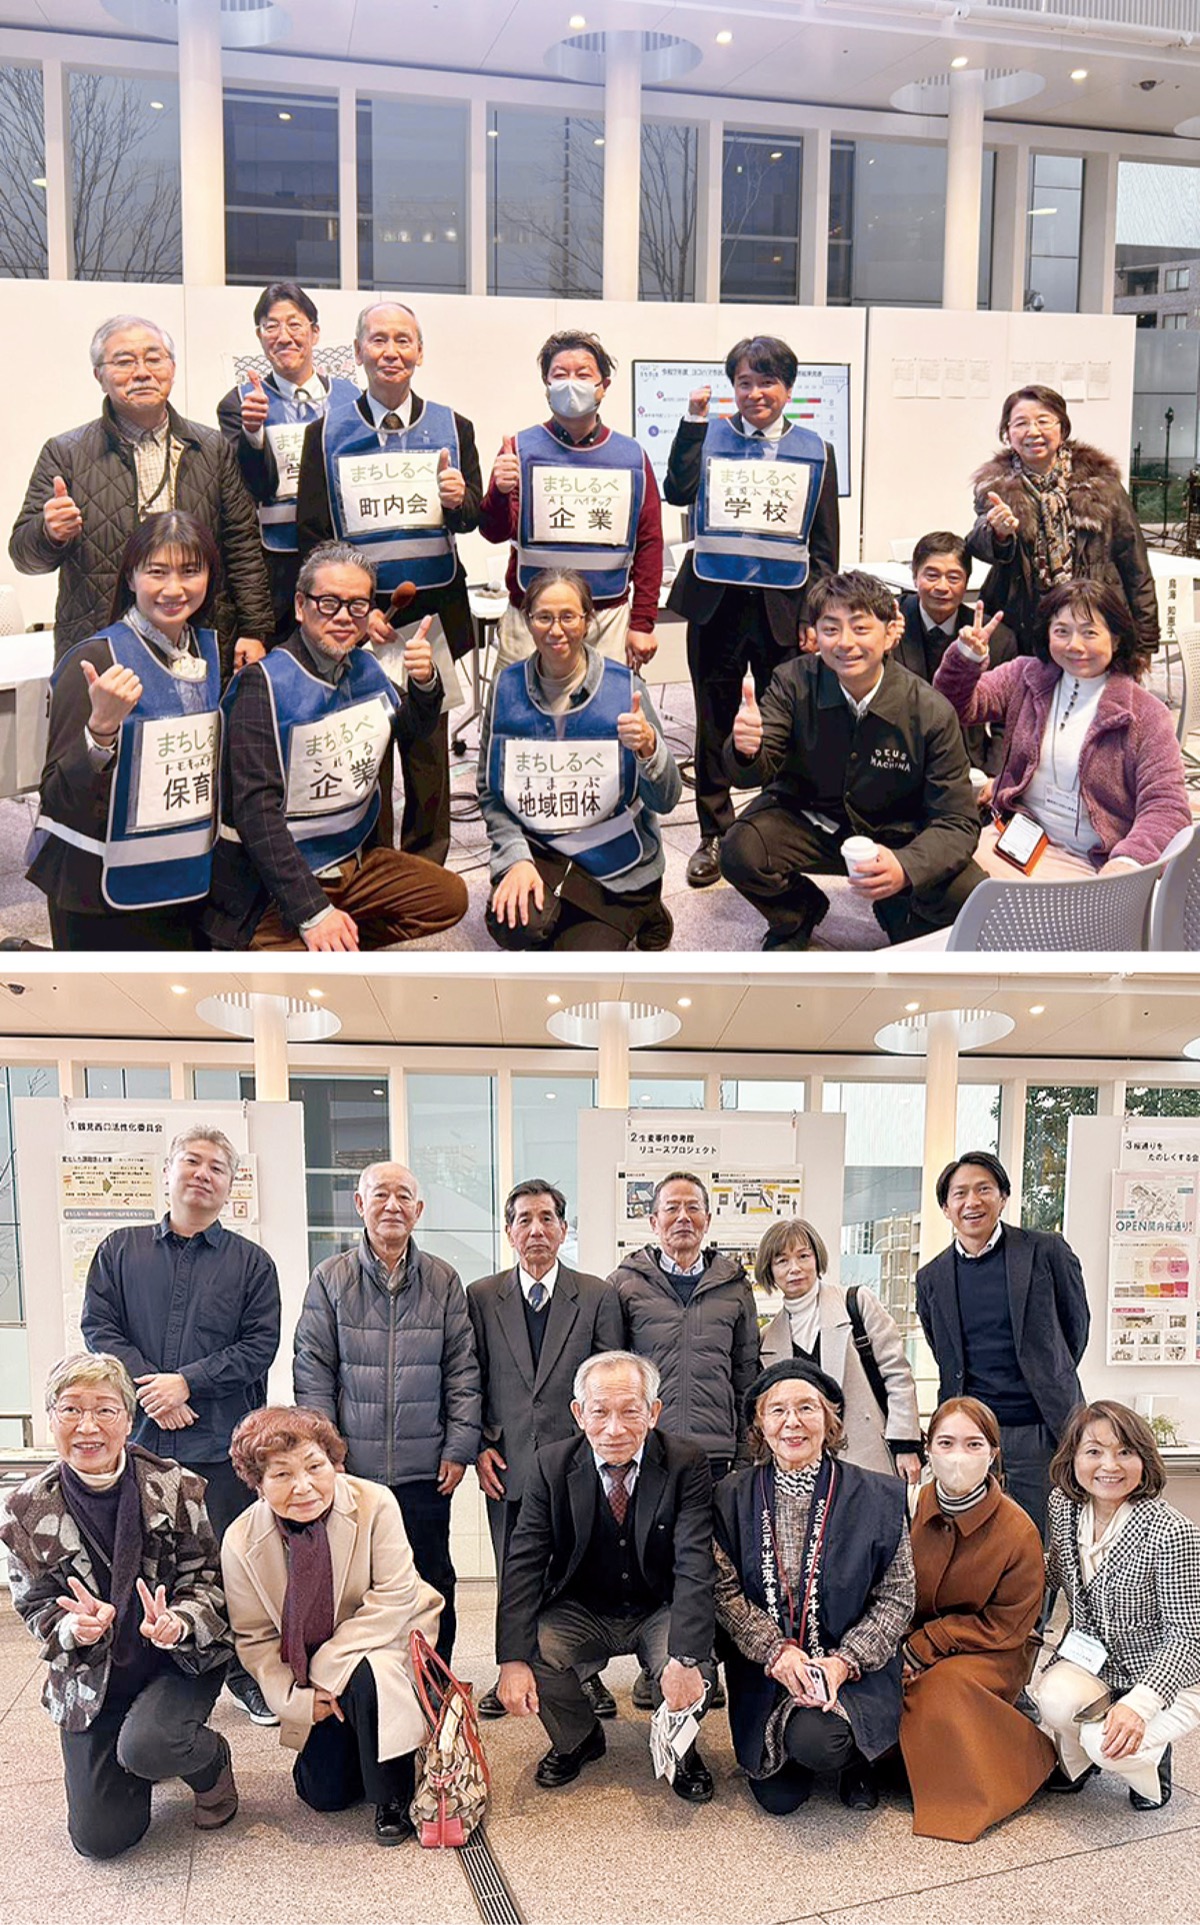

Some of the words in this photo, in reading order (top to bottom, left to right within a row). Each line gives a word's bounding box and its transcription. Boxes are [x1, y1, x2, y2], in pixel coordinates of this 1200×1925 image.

[350, 462, 434, 482] まちしるべ
[720, 468, 797, 486] まちしるべ
[543, 475, 619, 493] まちしるべ
[360, 493, 428, 518] 町内会
[724, 497, 789, 523] 学校
[548, 507, 613, 530] 企業
[516, 752, 604, 773] まちしるべ
[870, 755, 912, 773] MACHINA
[874, 748, 908, 761] DEUS
[309, 757, 377, 801] 企業
[517, 790, 601, 818] 地域団体
